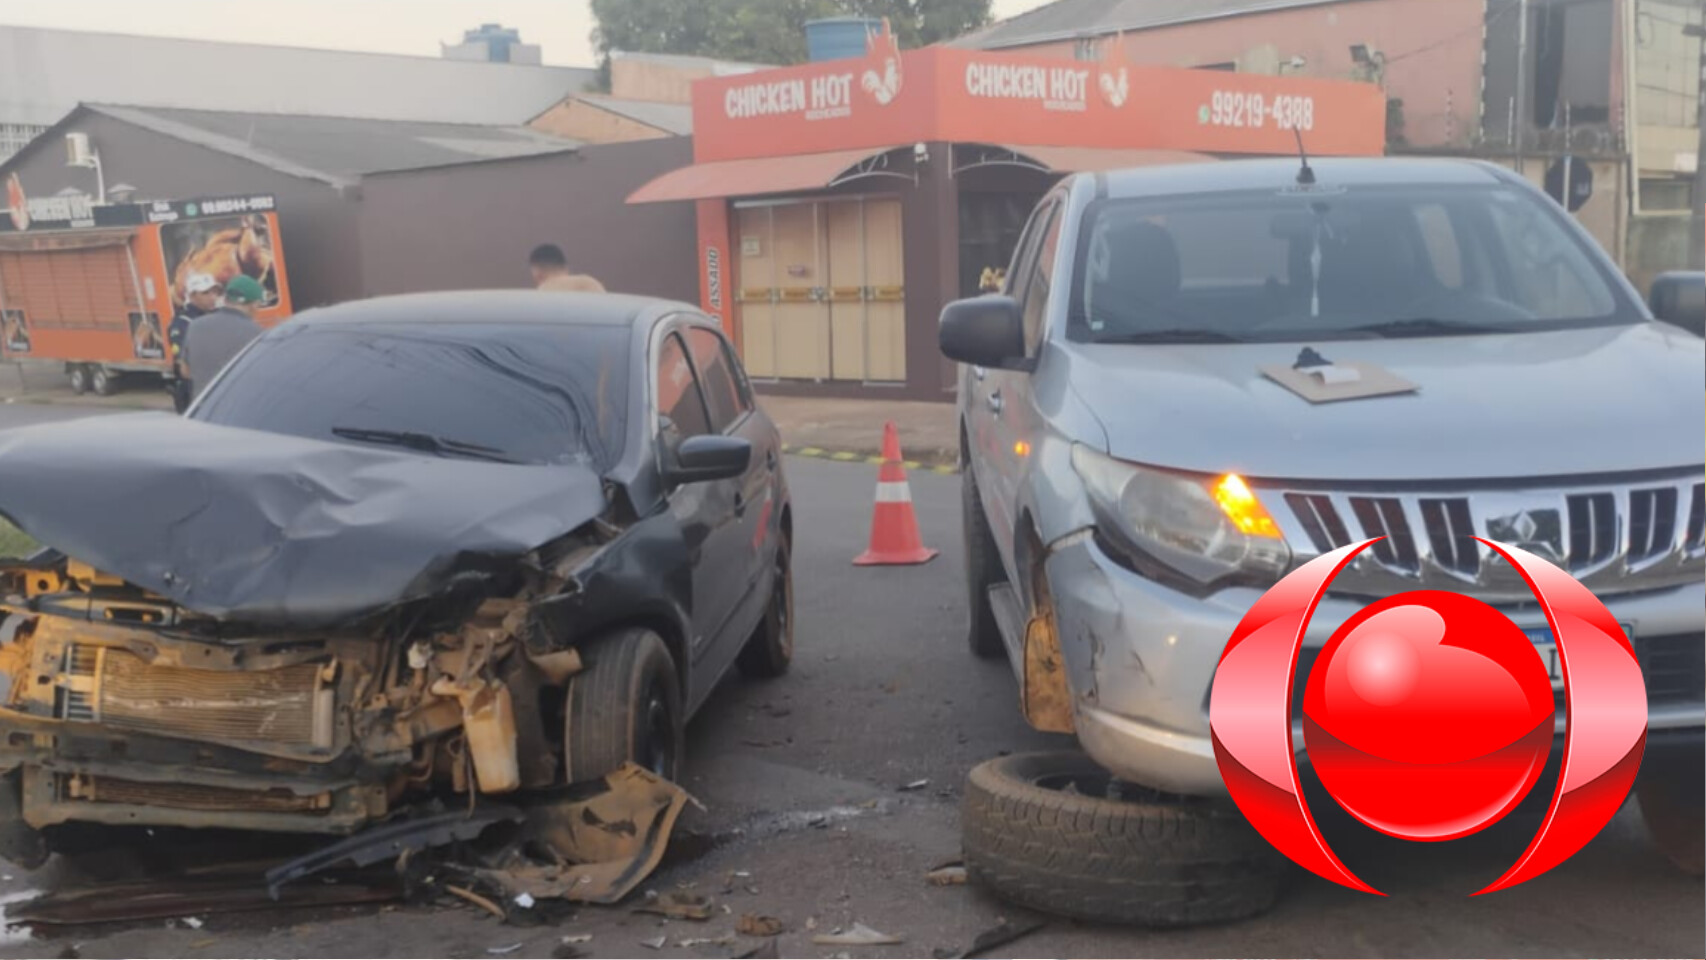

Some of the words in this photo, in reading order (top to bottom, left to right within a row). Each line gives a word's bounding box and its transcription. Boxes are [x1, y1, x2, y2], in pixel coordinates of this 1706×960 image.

[725, 80, 805, 118] CHICKEN
[812, 73, 853, 109] HOT
[965, 62, 1046, 99] CHICKEN
[1051, 67, 1089, 101] HOT
[1212, 91, 1313, 130] 99219-4388
